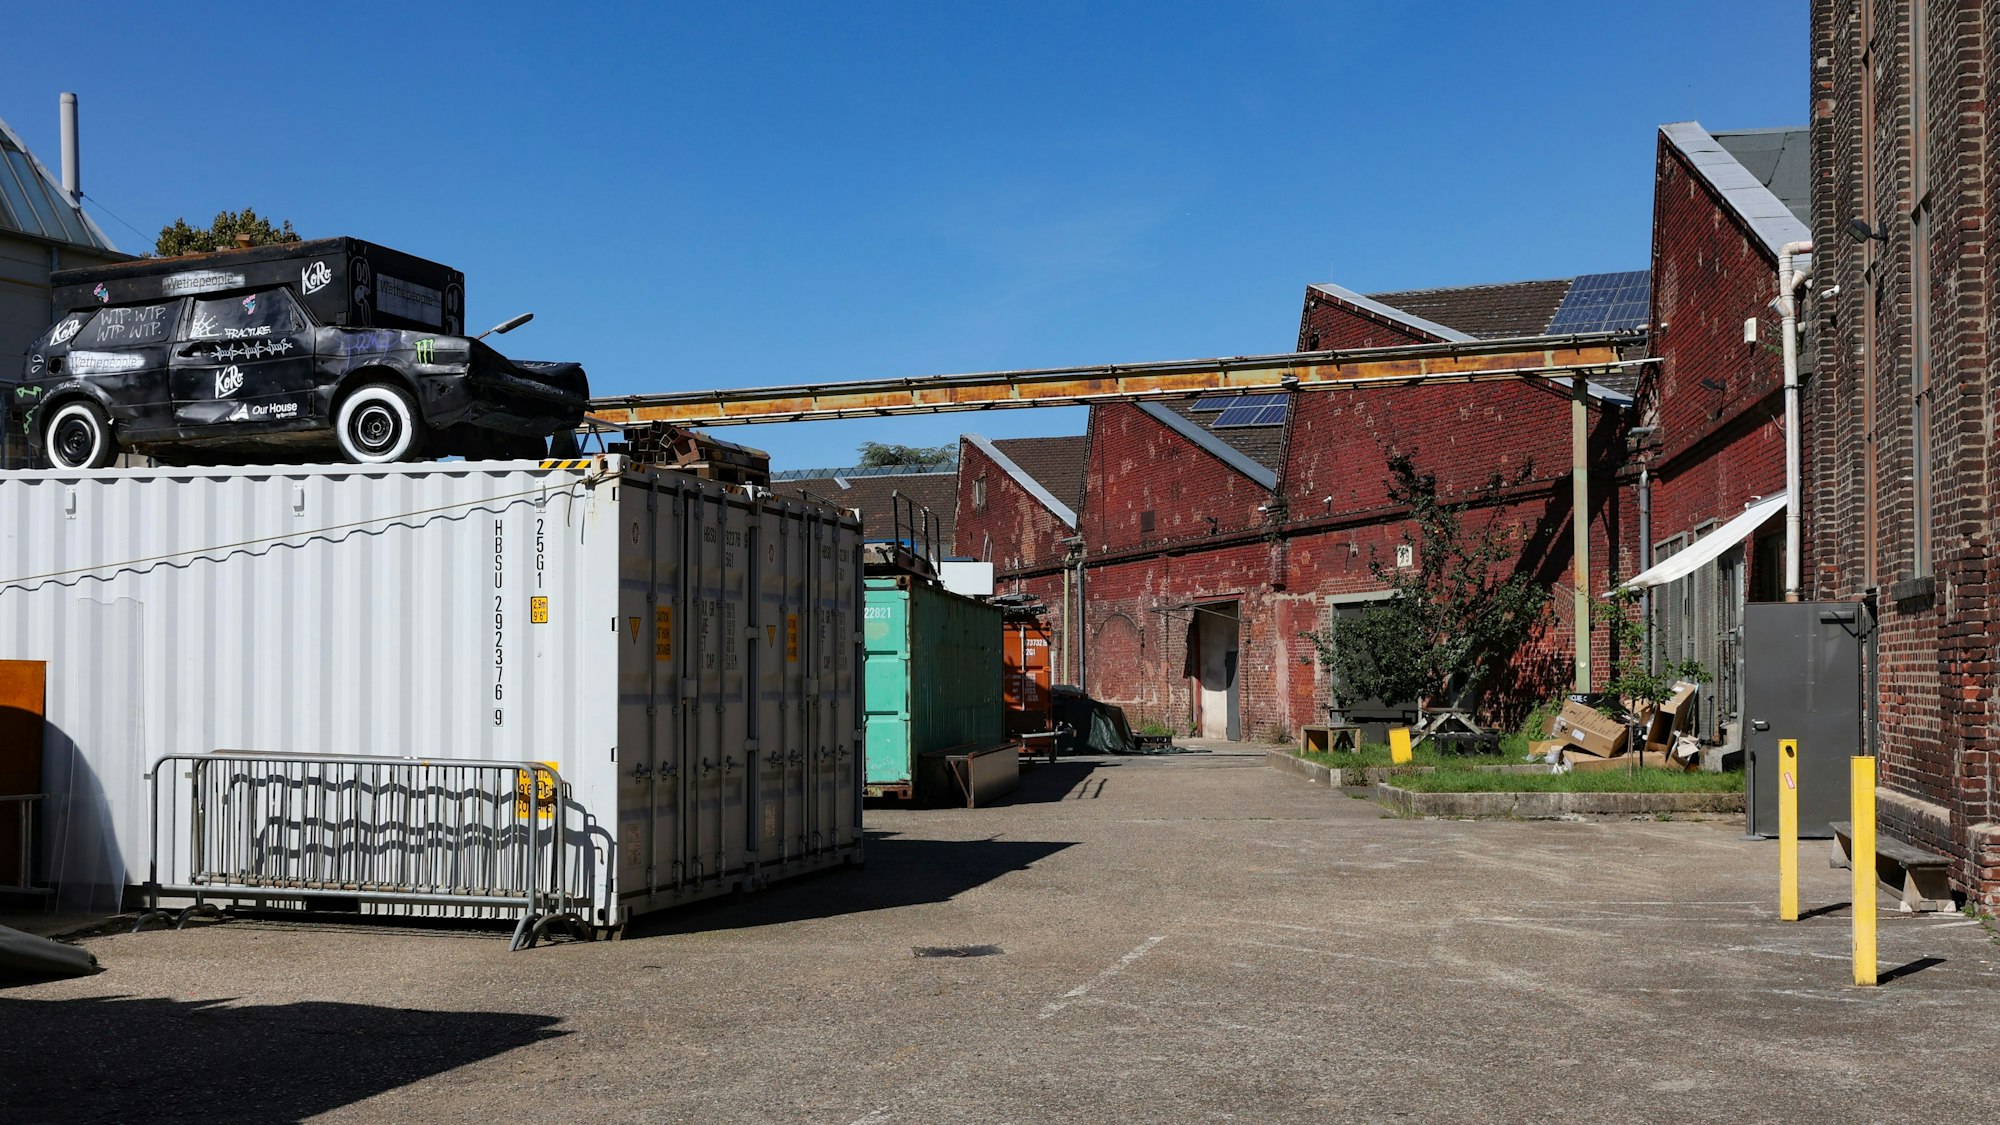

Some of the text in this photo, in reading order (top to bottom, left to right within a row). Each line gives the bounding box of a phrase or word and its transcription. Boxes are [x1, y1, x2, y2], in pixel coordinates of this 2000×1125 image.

[166, 274, 233, 291] Wethepeople
[72, 356, 137, 370] Wethepeople
[252, 402, 298, 416] Our House
[495, 519, 503, 589] HBSU
[536, 519, 545, 589] 25G1
[495, 595, 503, 701] 292376
